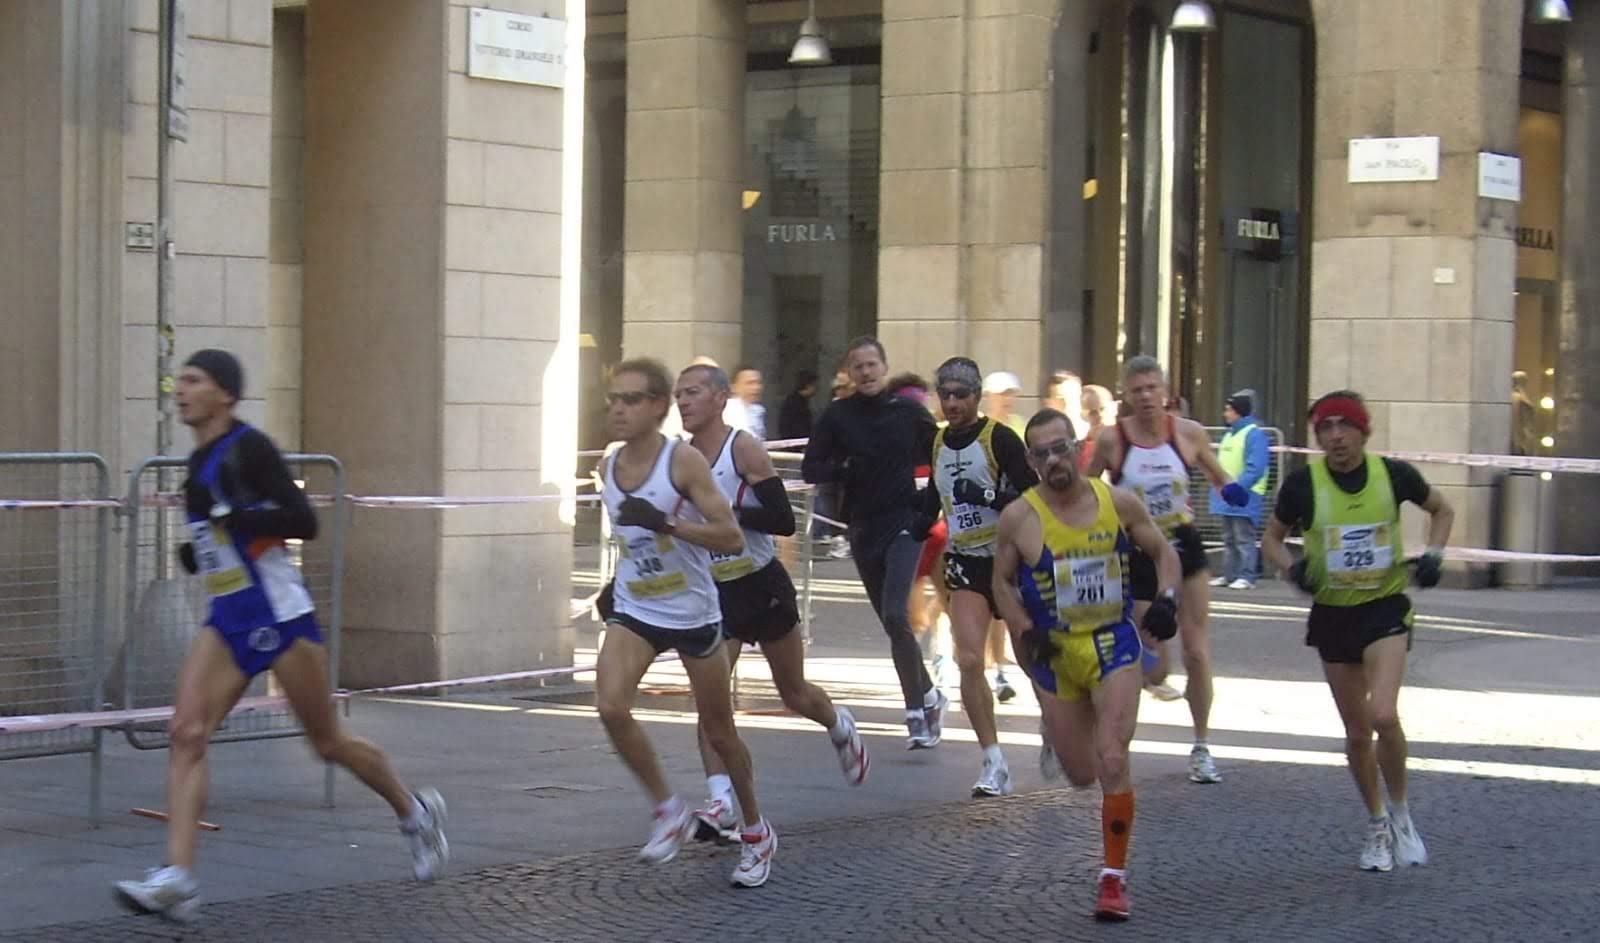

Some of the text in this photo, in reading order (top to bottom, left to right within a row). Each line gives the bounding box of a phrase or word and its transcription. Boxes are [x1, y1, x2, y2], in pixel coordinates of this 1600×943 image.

[767, 223, 836, 243] FURLA
[1237, 218, 1280, 240] FURLA
[956, 510, 983, 530] 256
[1343, 549, 1375, 568] 329
